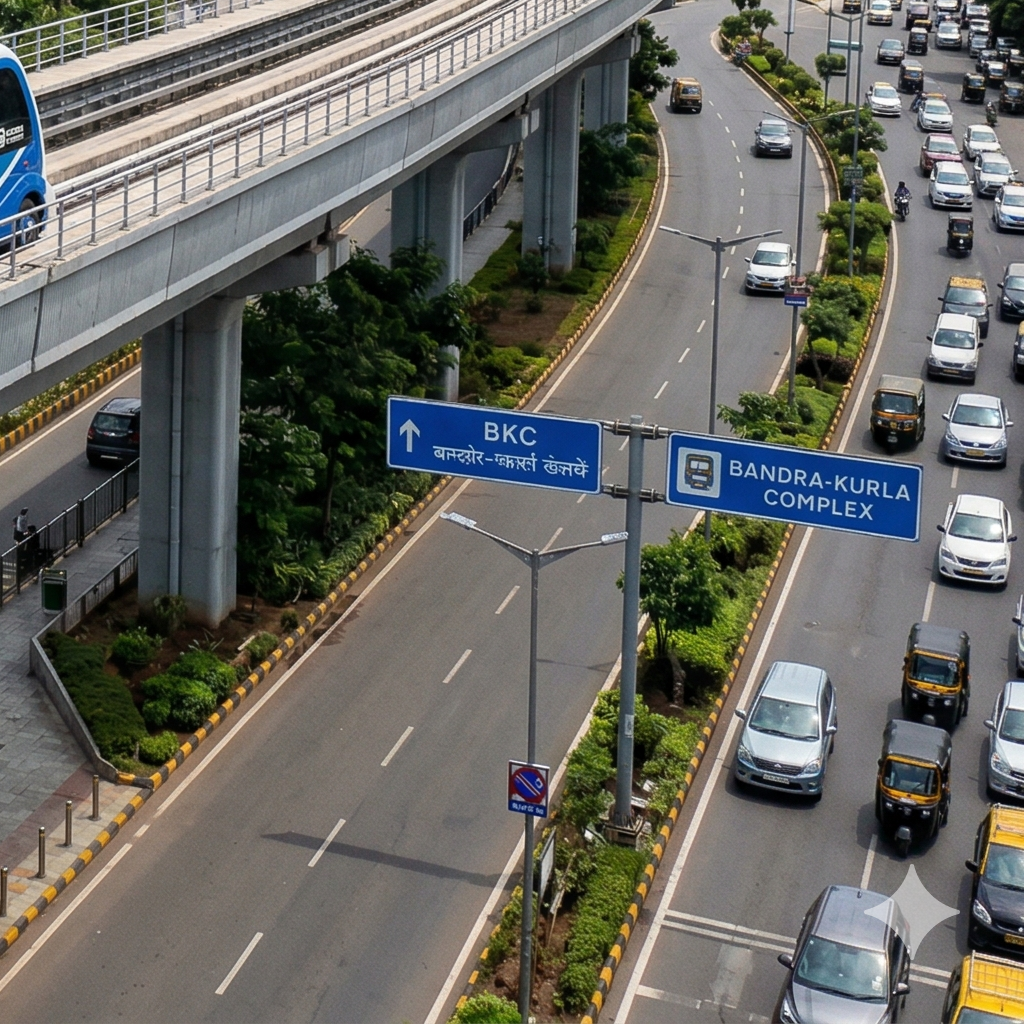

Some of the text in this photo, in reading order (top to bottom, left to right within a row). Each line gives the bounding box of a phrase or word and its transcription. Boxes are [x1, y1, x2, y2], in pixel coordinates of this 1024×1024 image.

[484, 421, 537, 447] BKC
[729, 459, 911, 502] BANDRA-KURLA
[763, 489, 874, 521] COMPLEX
